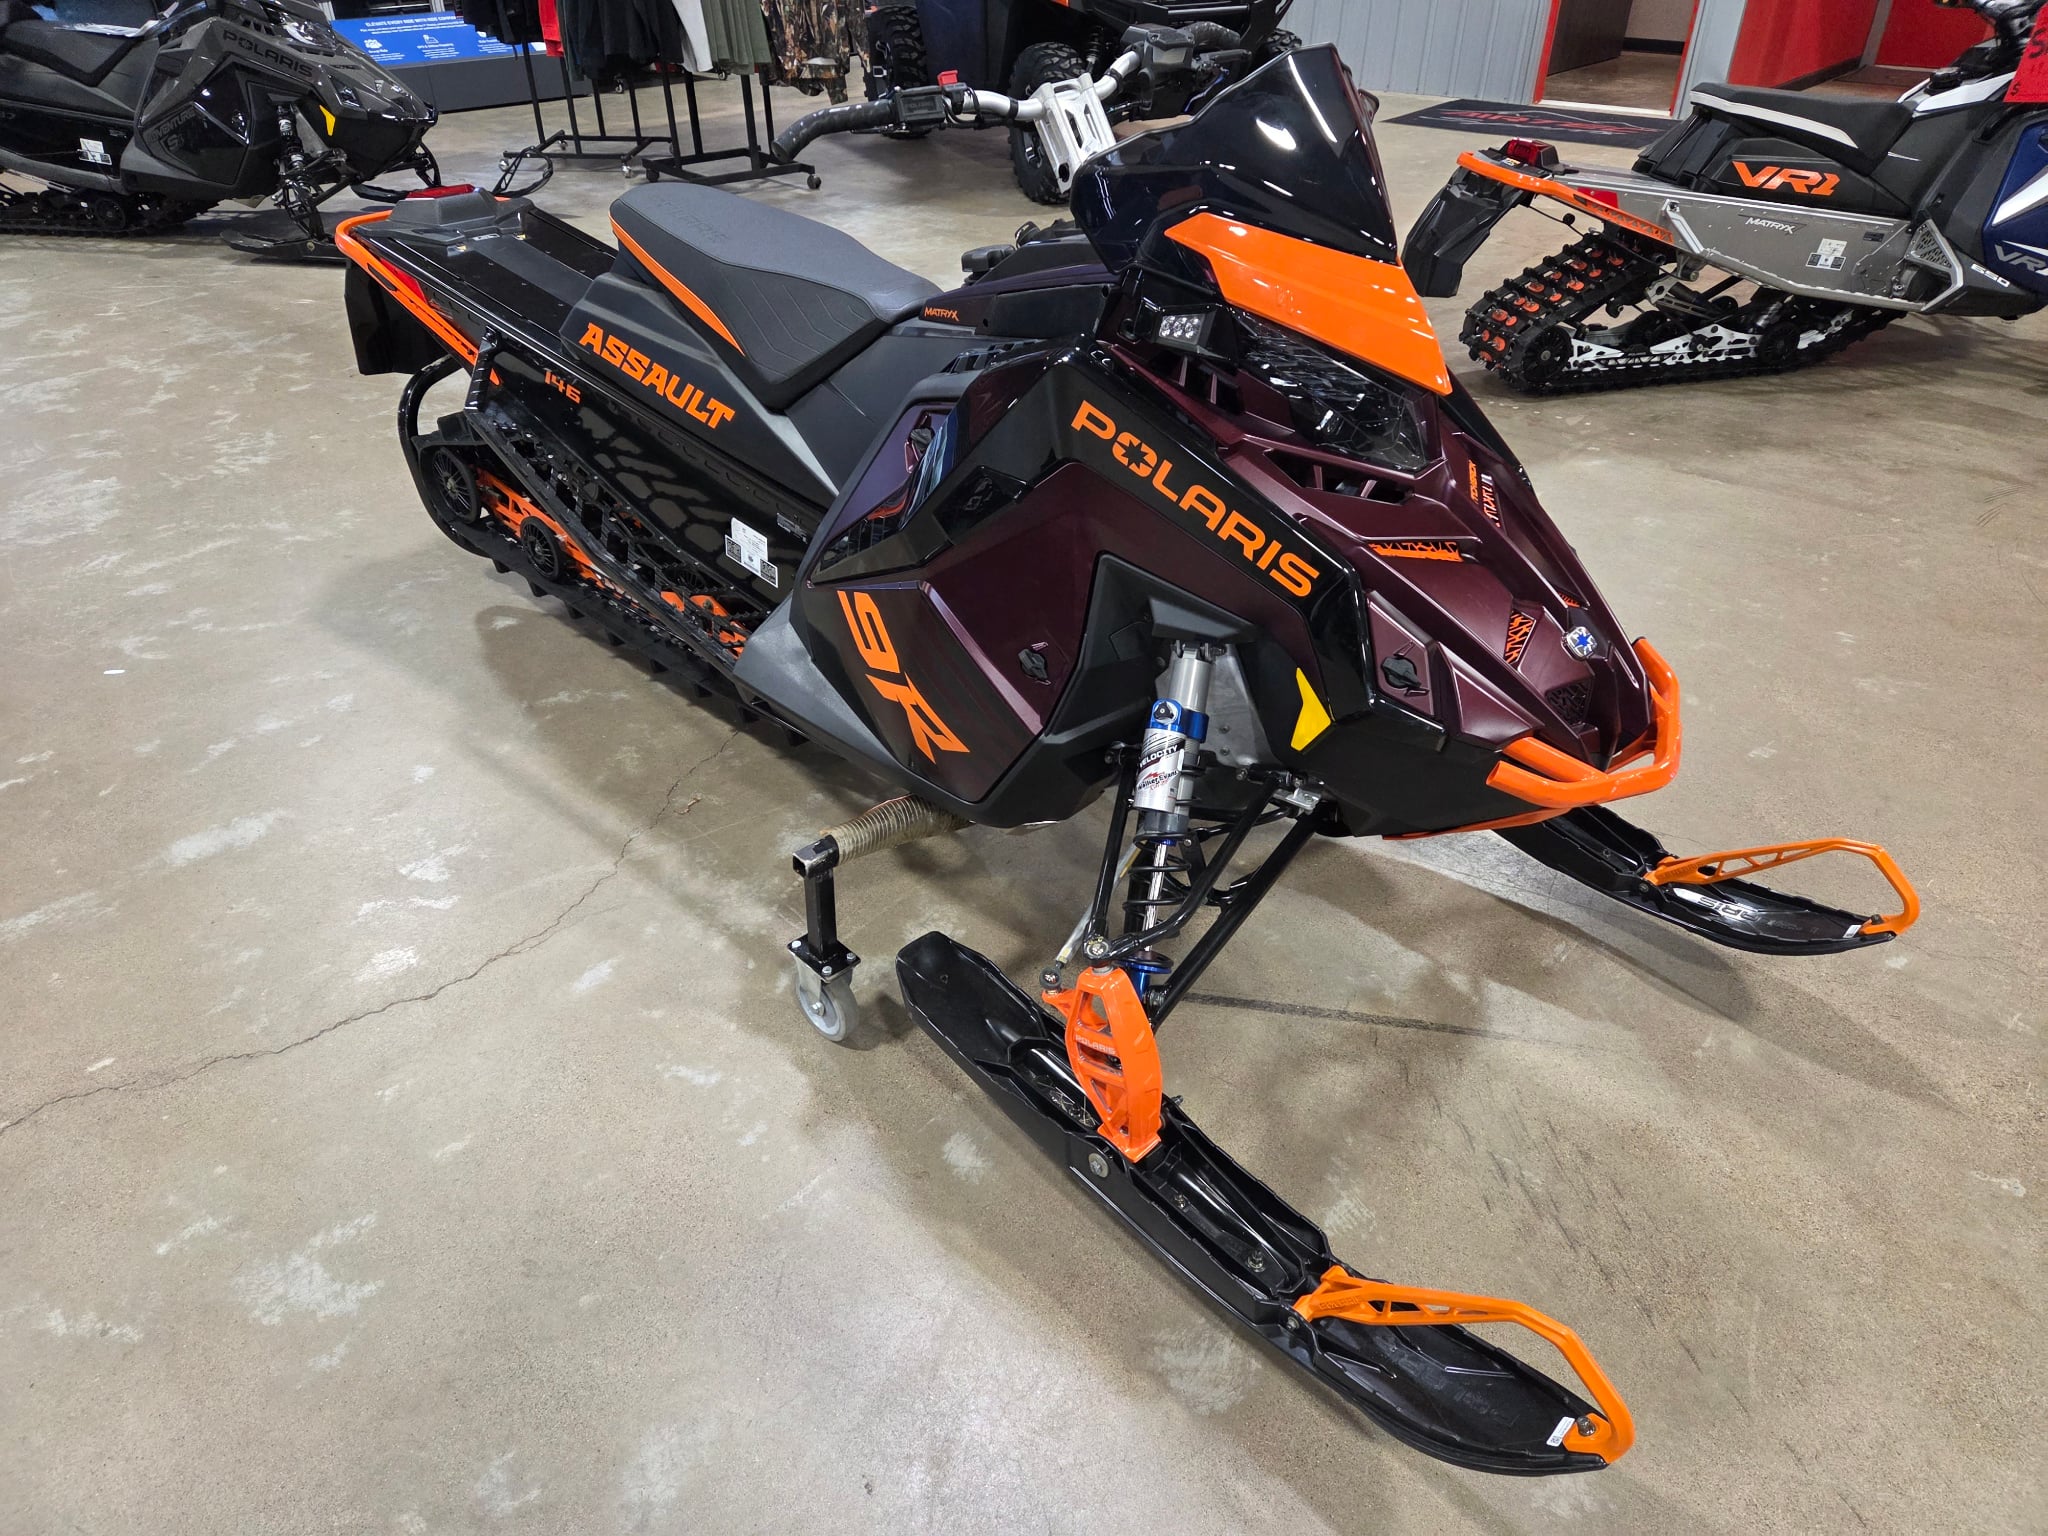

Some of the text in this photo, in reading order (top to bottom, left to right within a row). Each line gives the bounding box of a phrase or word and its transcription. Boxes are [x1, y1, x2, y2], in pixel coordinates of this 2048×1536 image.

[223, 29, 313, 78] POLARIS
[1745, 217, 1796, 235] MATRYX
[924, 306, 960, 322] MATRYX
[544, 370, 582, 404] 146
[578, 321, 736, 429] ASSAULT
[1070, 399, 1320, 597] POLARIS
